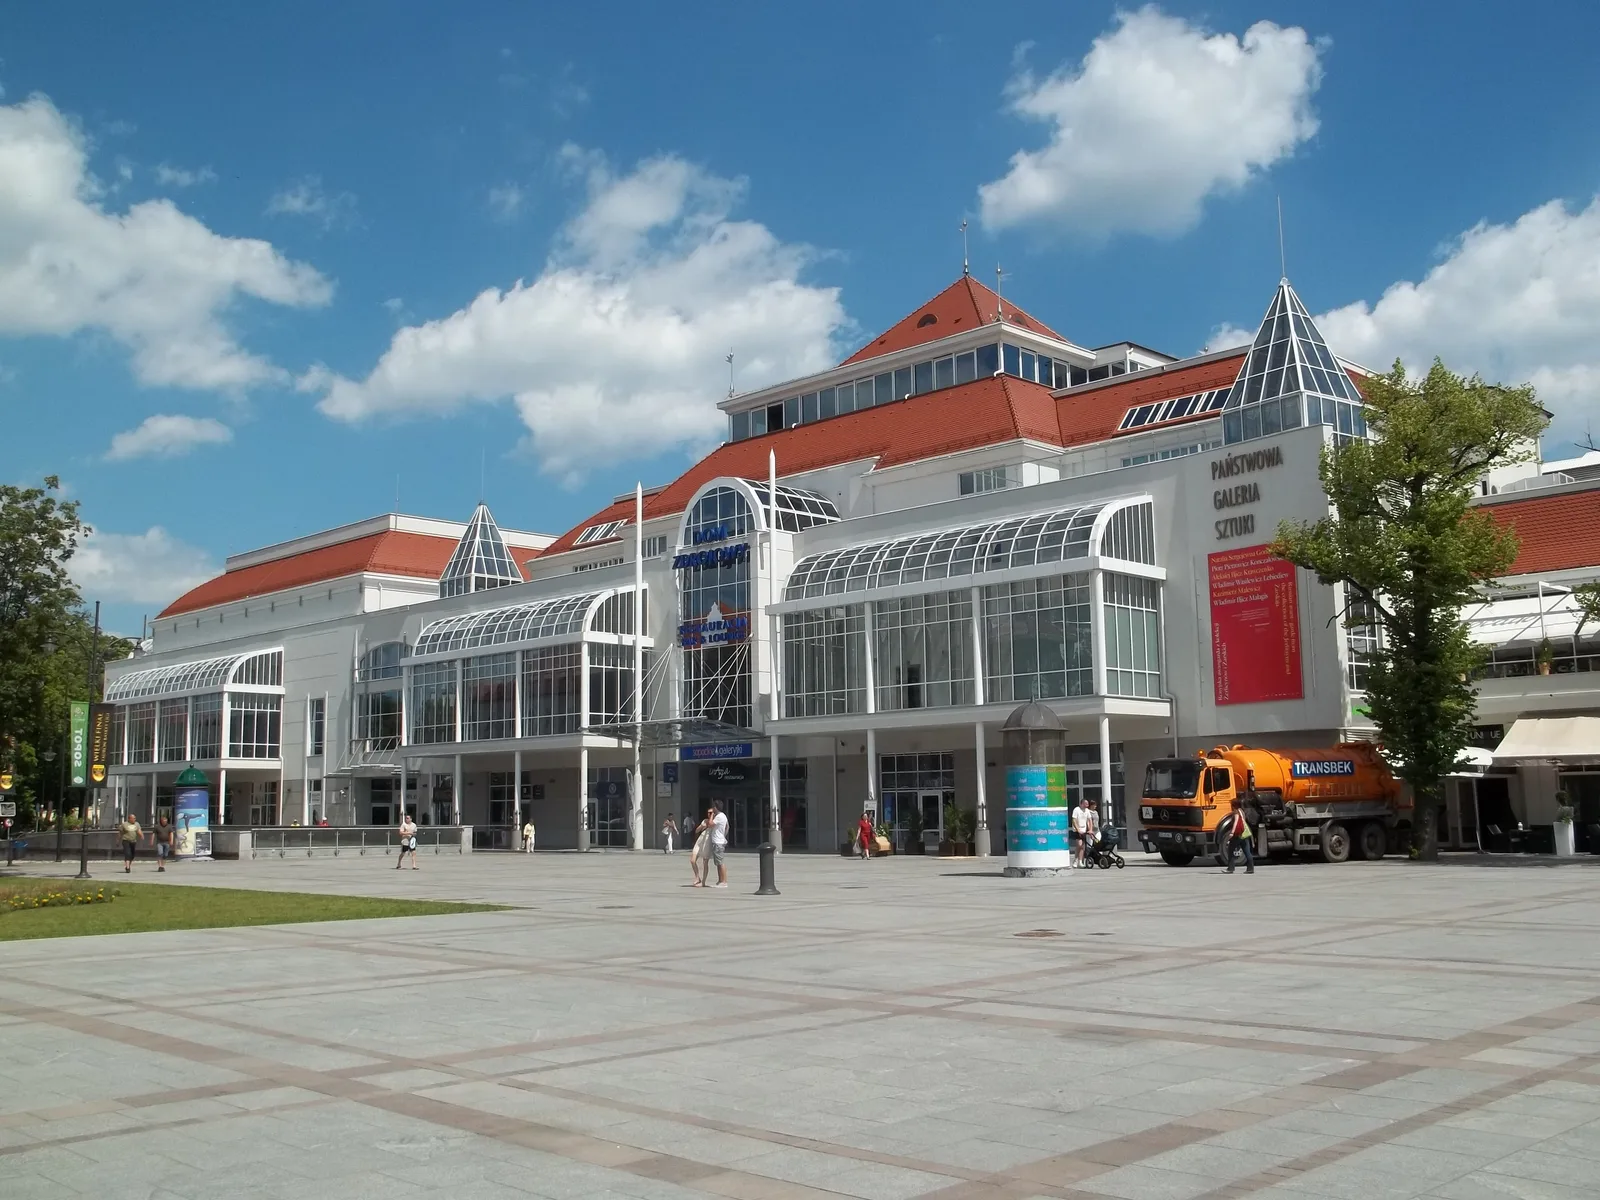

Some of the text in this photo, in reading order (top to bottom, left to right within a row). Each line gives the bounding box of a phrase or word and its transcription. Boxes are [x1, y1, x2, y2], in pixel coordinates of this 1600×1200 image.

[1211, 446, 1283, 480] PAŃSTWOWA
[1213, 482, 1260, 510] GALERIA
[694, 525, 727, 545] DOM
[1215, 514, 1255, 541] SZTUKI
[1294, 761, 1352, 775] TRANSBEK
